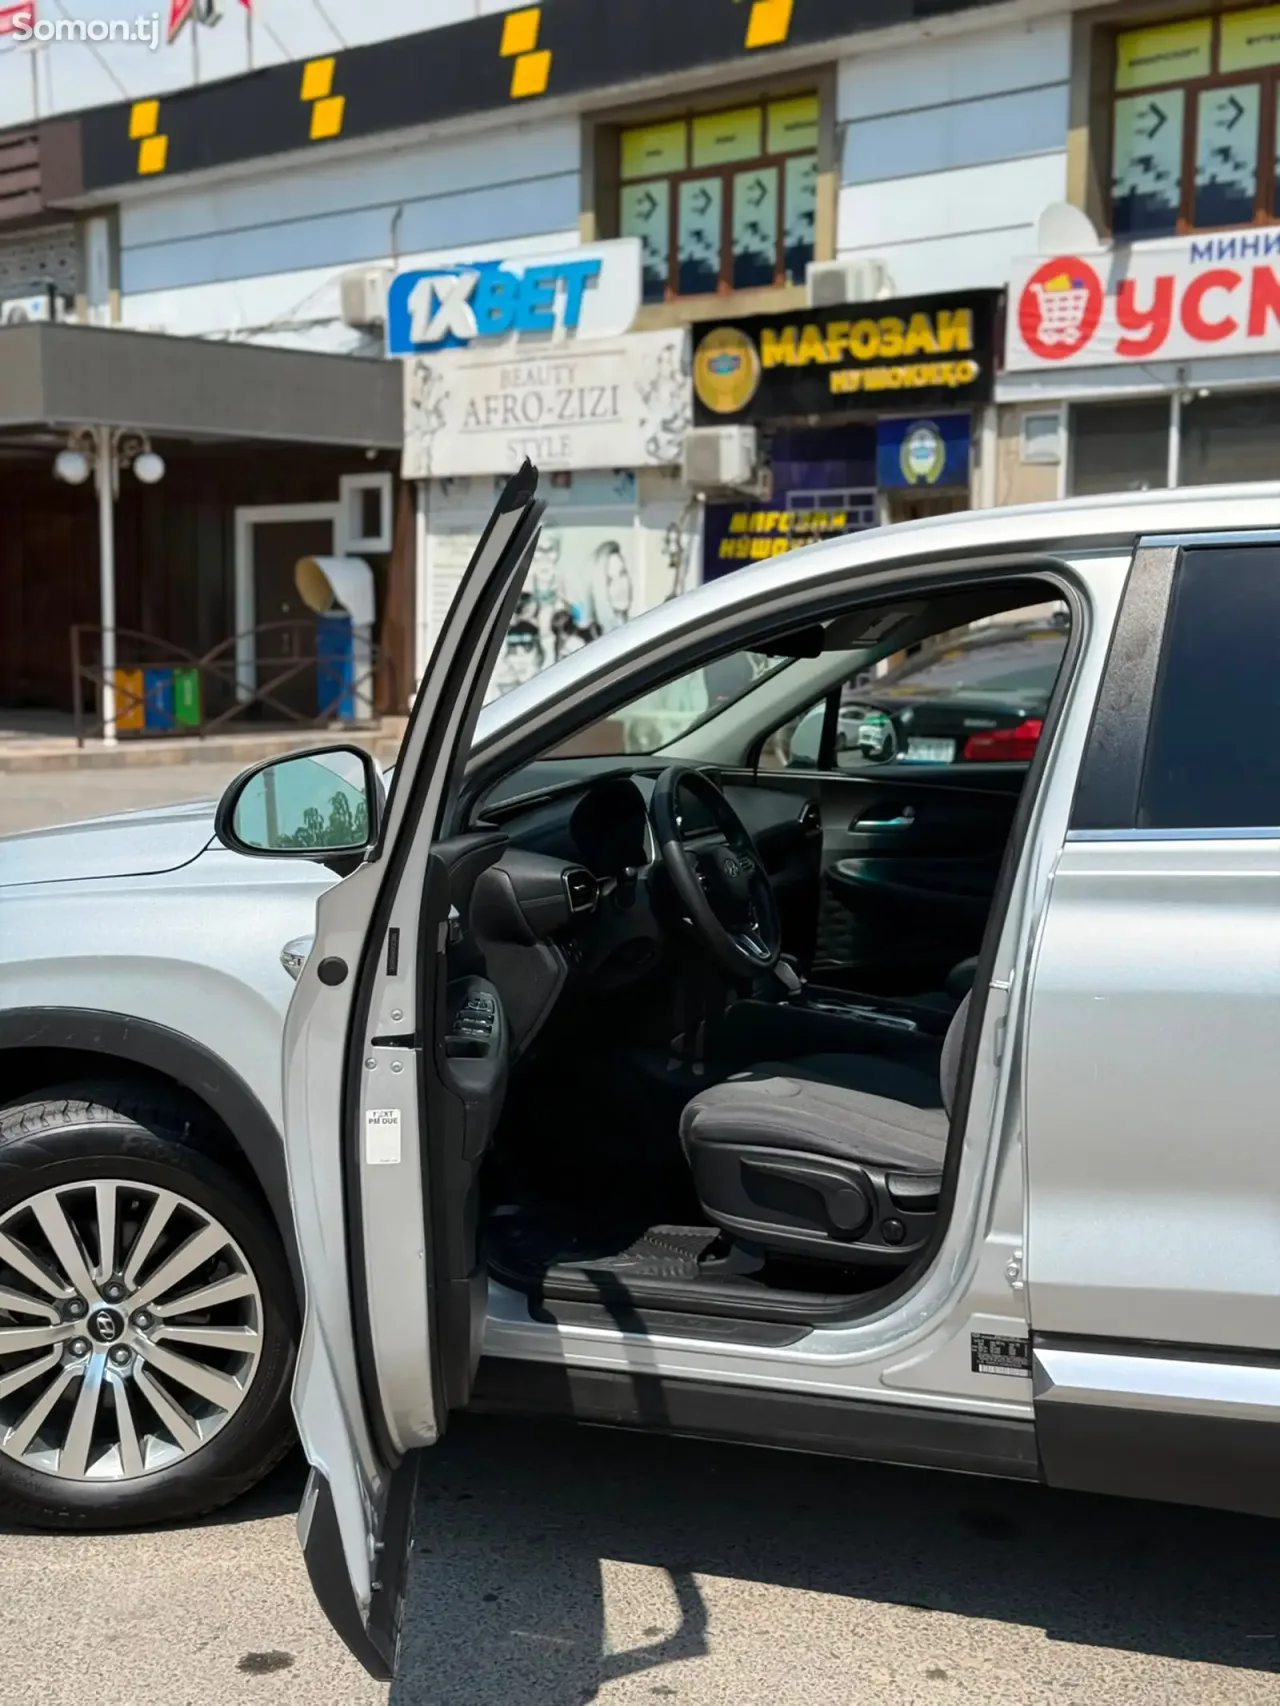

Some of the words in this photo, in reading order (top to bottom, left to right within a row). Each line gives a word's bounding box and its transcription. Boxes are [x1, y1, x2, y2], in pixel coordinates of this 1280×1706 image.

[499, 362, 581, 390] BEAUTY
[462, 385, 621, 429] AFRO-ZIZI
[507, 435, 573, 461] STYLE
[382, 1117, 399, 1125] DUE
